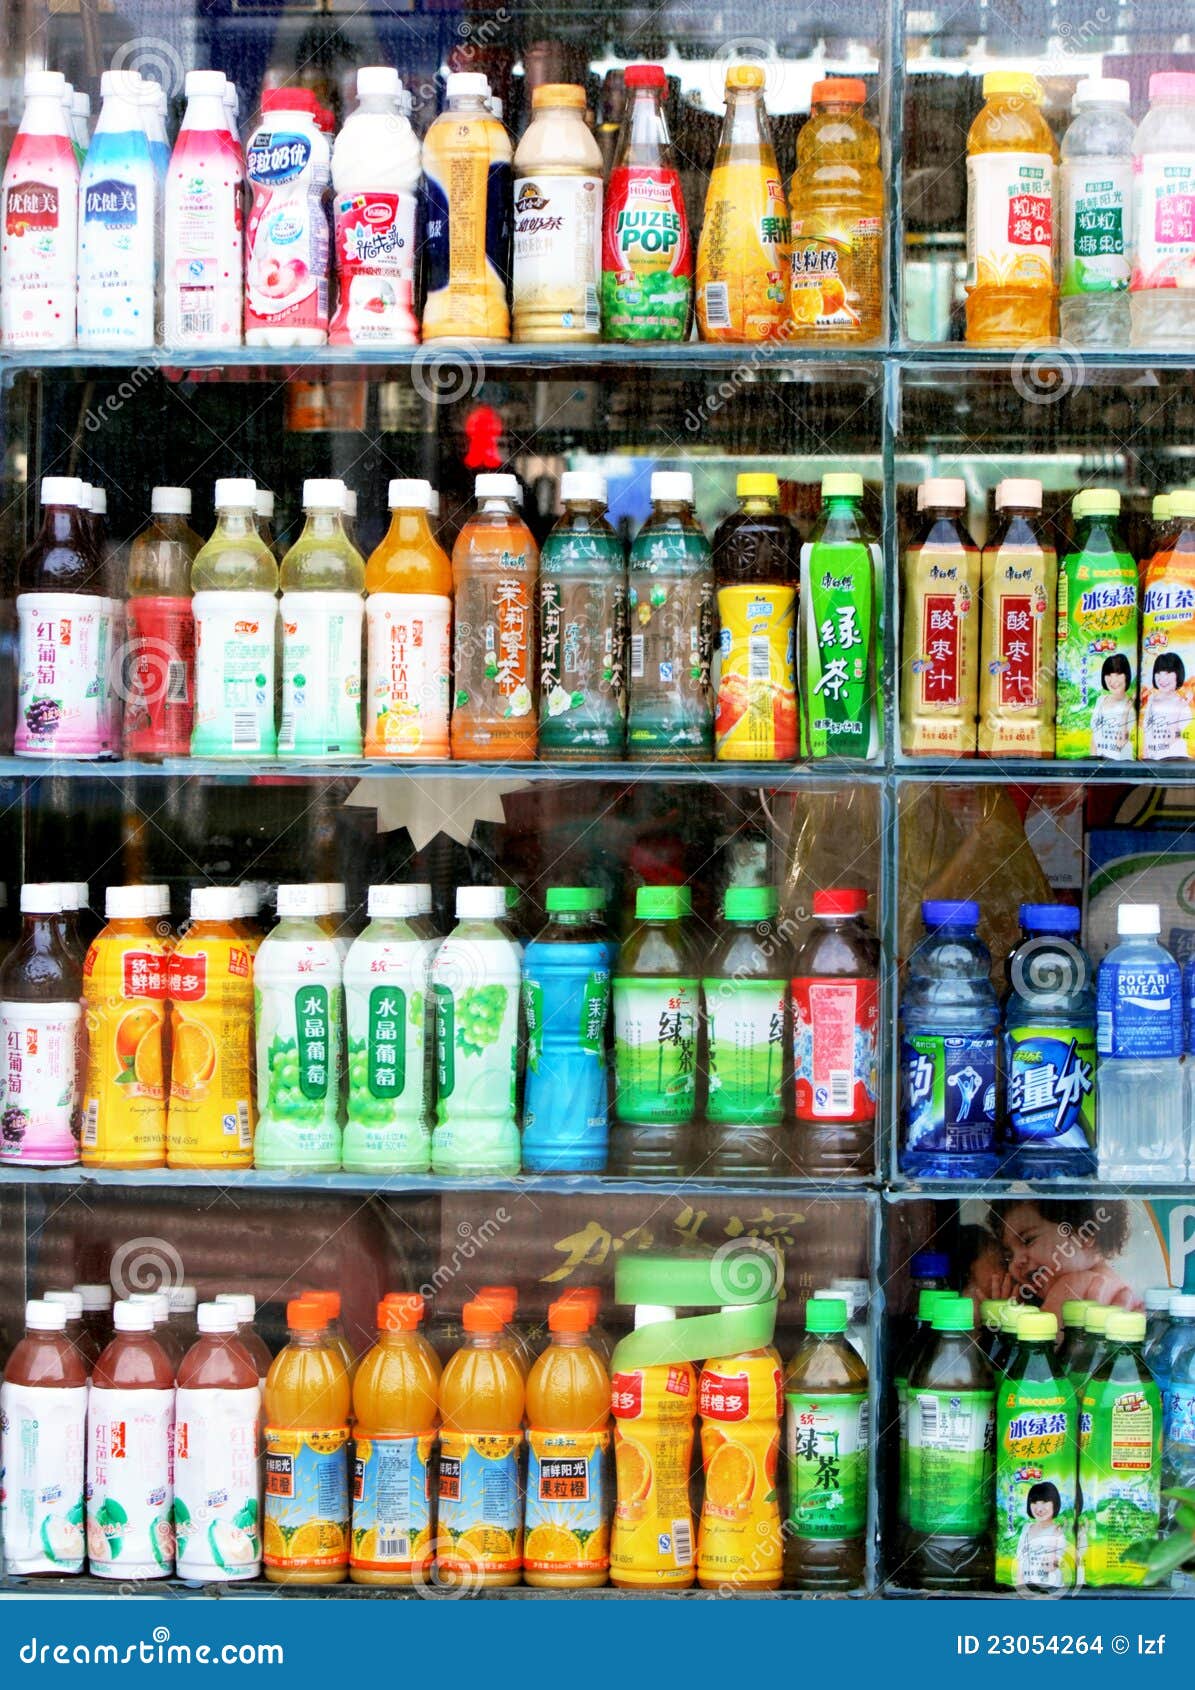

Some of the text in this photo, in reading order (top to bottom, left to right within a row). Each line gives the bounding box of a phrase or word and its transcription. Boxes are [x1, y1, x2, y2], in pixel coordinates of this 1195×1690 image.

[8, 192, 57, 213] 优健美
[86, 192, 136, 213] 优健美
[616, 211, 681, 234] JUIZEE
[622, 228, 678, 253] POP
[1083, 586, 1135, 611] 冰绿茶
[37, 622, 56, 685] 红葡萄
[928, 609, 955, 690] 酸枣汁
[1005, 611, 1033, 690] 酸枣汁
[132, 959, 159, 973] 统一
[1118, 975, 1169, 985] POCARI
[1118, 985, 1166, 995] SWEAT
[302, 996, 326, 1085] 水晶葡萄
[376, 997, 398, 1087] 水晶葡萄
[7, 1031, 22, 1094] 红葡萄
[800, 1413, 829, 1425] 统一
[1010, 1413, 1066, 1439] 冰绿茶
[542, 1461, 585, 1477] 新鲜阳光
[796, 1426, 840, 1490] 绿茶
[541, 1480, 585, 1497] 果粒橙
